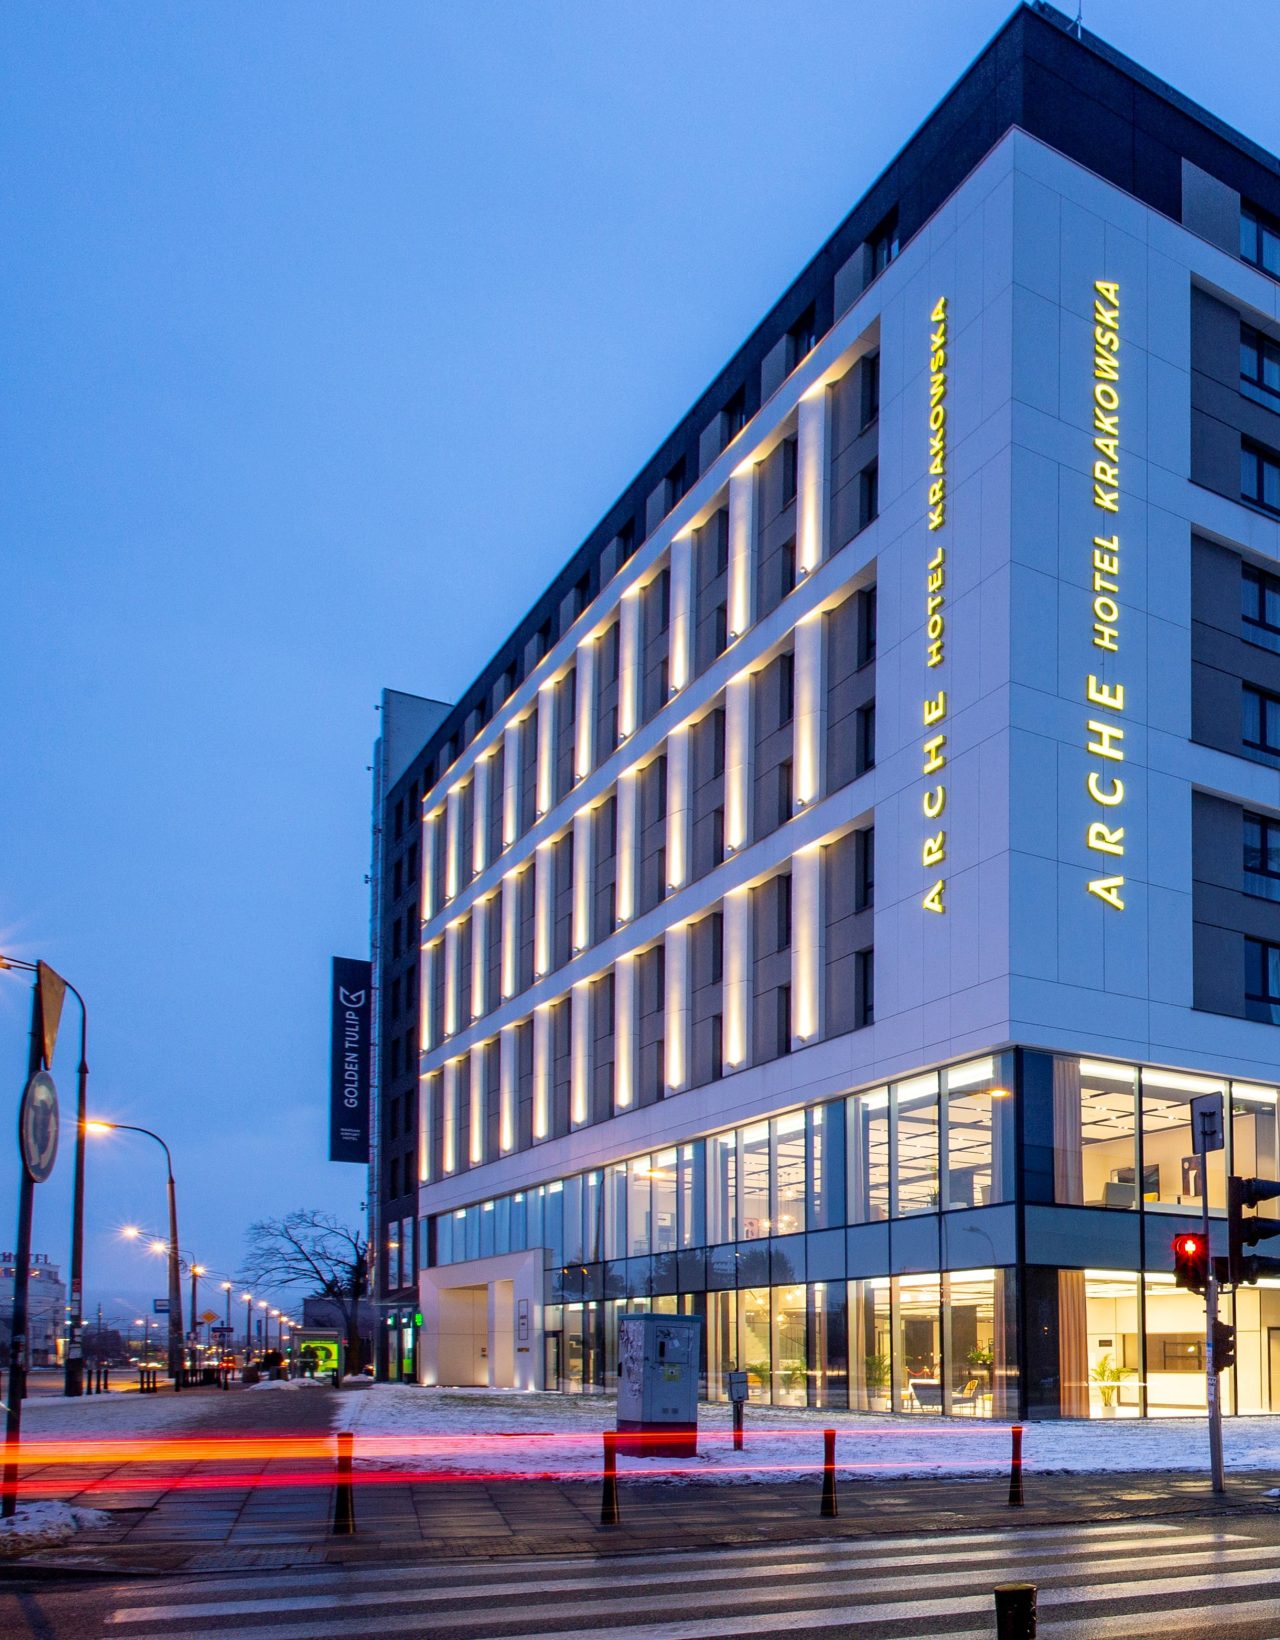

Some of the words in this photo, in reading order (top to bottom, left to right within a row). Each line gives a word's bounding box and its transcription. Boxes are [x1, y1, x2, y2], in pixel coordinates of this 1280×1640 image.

[928, 296, 948, 531] KRAKOWSKA
[1093, 279, 1120, 512] KRAKOWSKA
[927, 546, 945, 668] HOTEL
[1093, 534, 1120, 651] HOTEL
[922, 690, 946, 914] ARCHE
[1086, 674, 1125, 911] ARCHE
[343, 1052, 360, 1108] GOLDEN
[344, 1011, 360, 1048] TULIP
[2, 1252, 50, 1264] HEL
